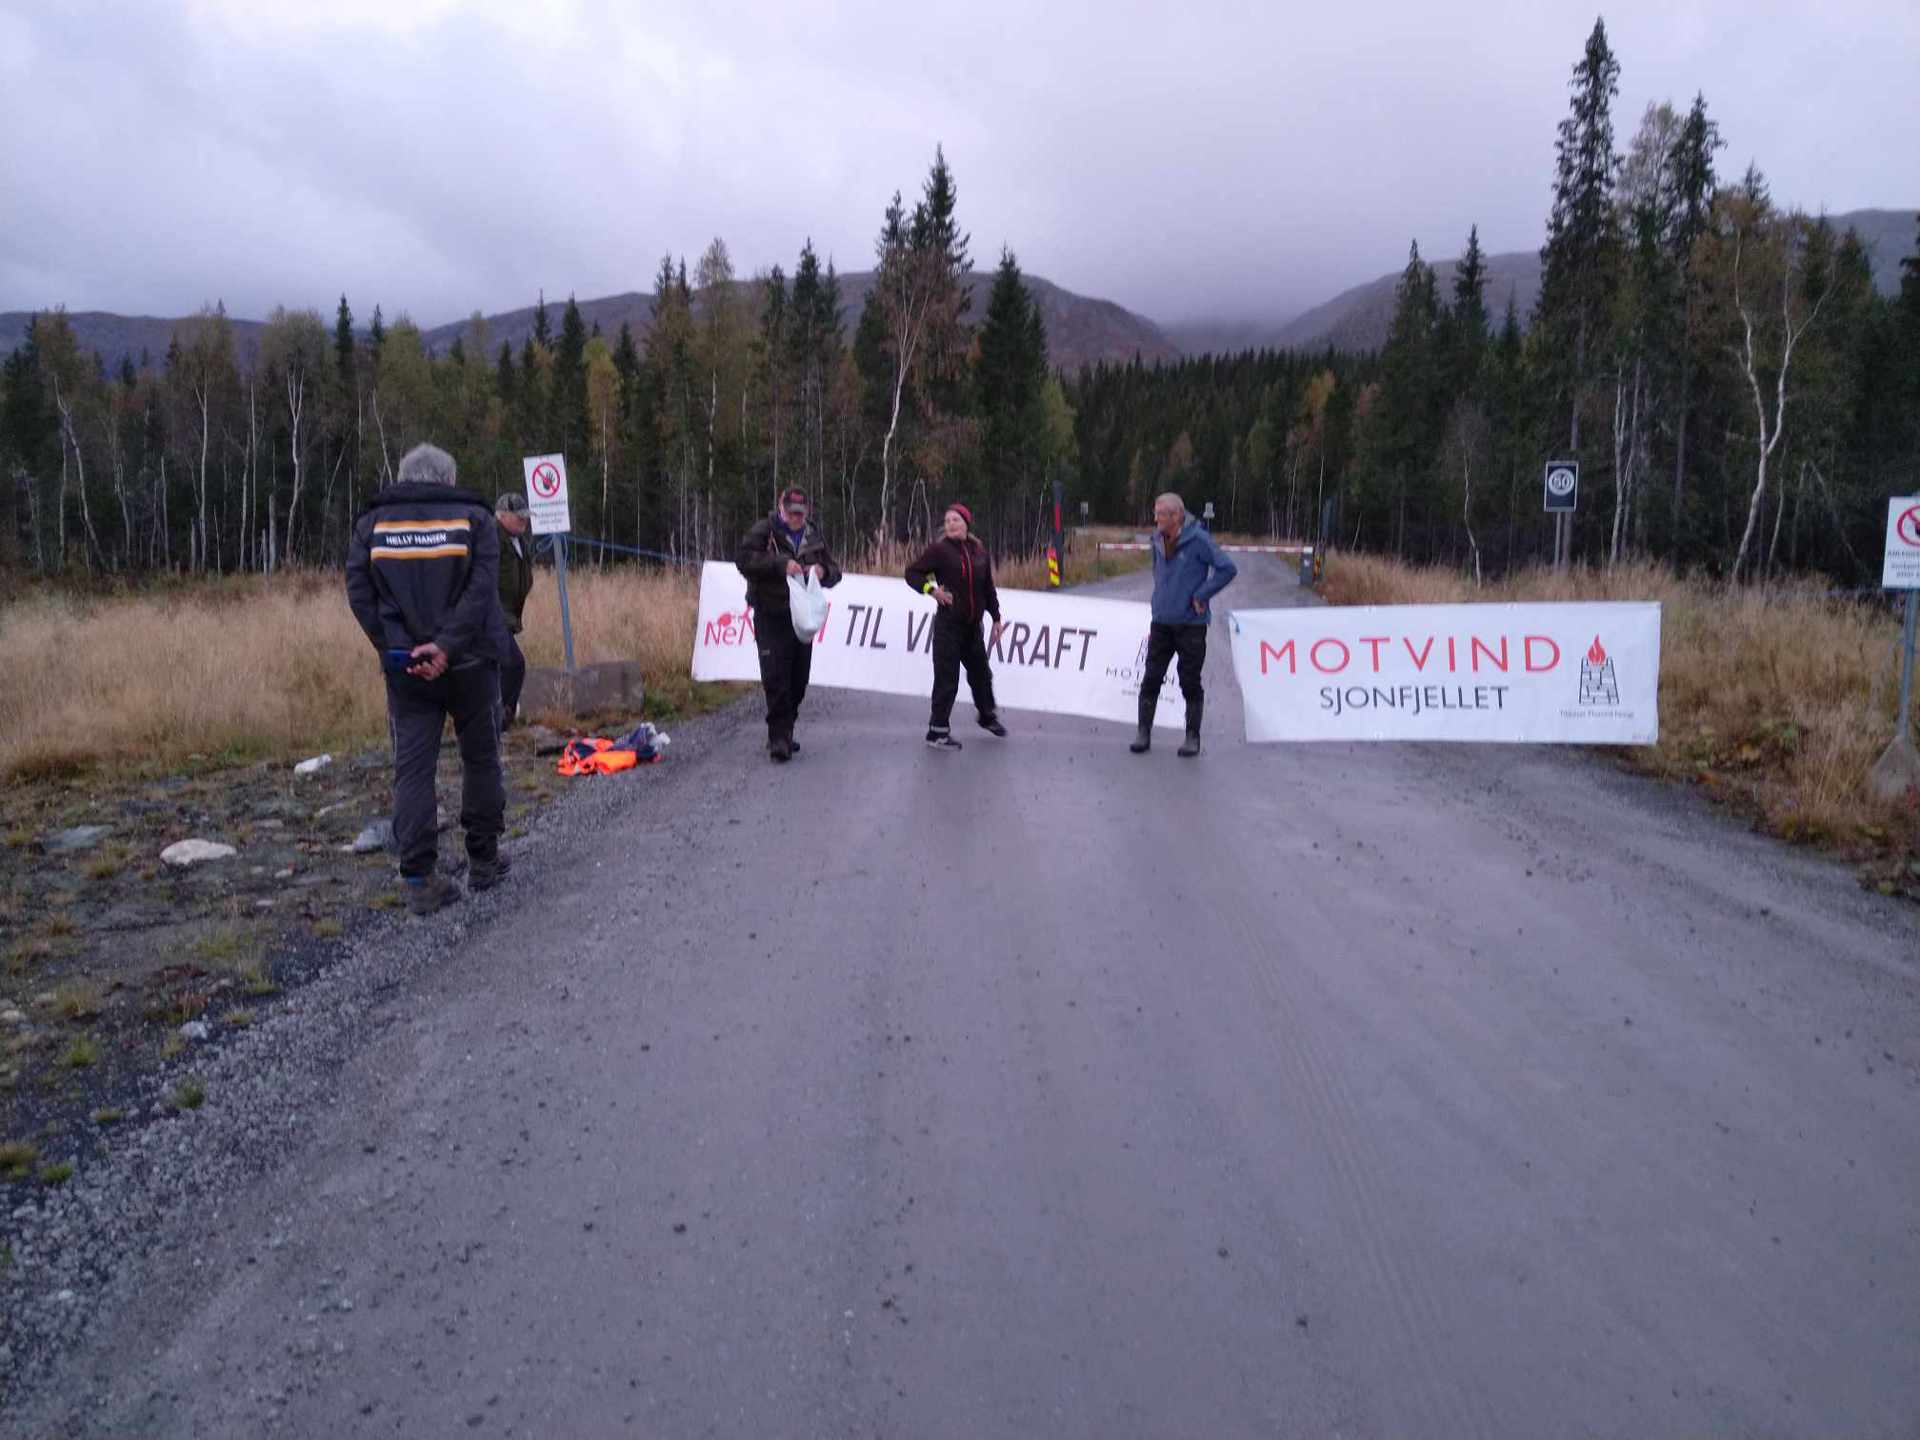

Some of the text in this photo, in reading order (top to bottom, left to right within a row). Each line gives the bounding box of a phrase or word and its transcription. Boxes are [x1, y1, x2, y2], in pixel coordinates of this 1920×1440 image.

[386, 534, 413, 545] HELLY
[845, 603, 887, 649] TIL
[906, 610, 1098, 672] VIKRAFT
[1260, 636, 1561, 675] MOTVIND
[1320, 685, 1510, 716] SJONFJELLET
